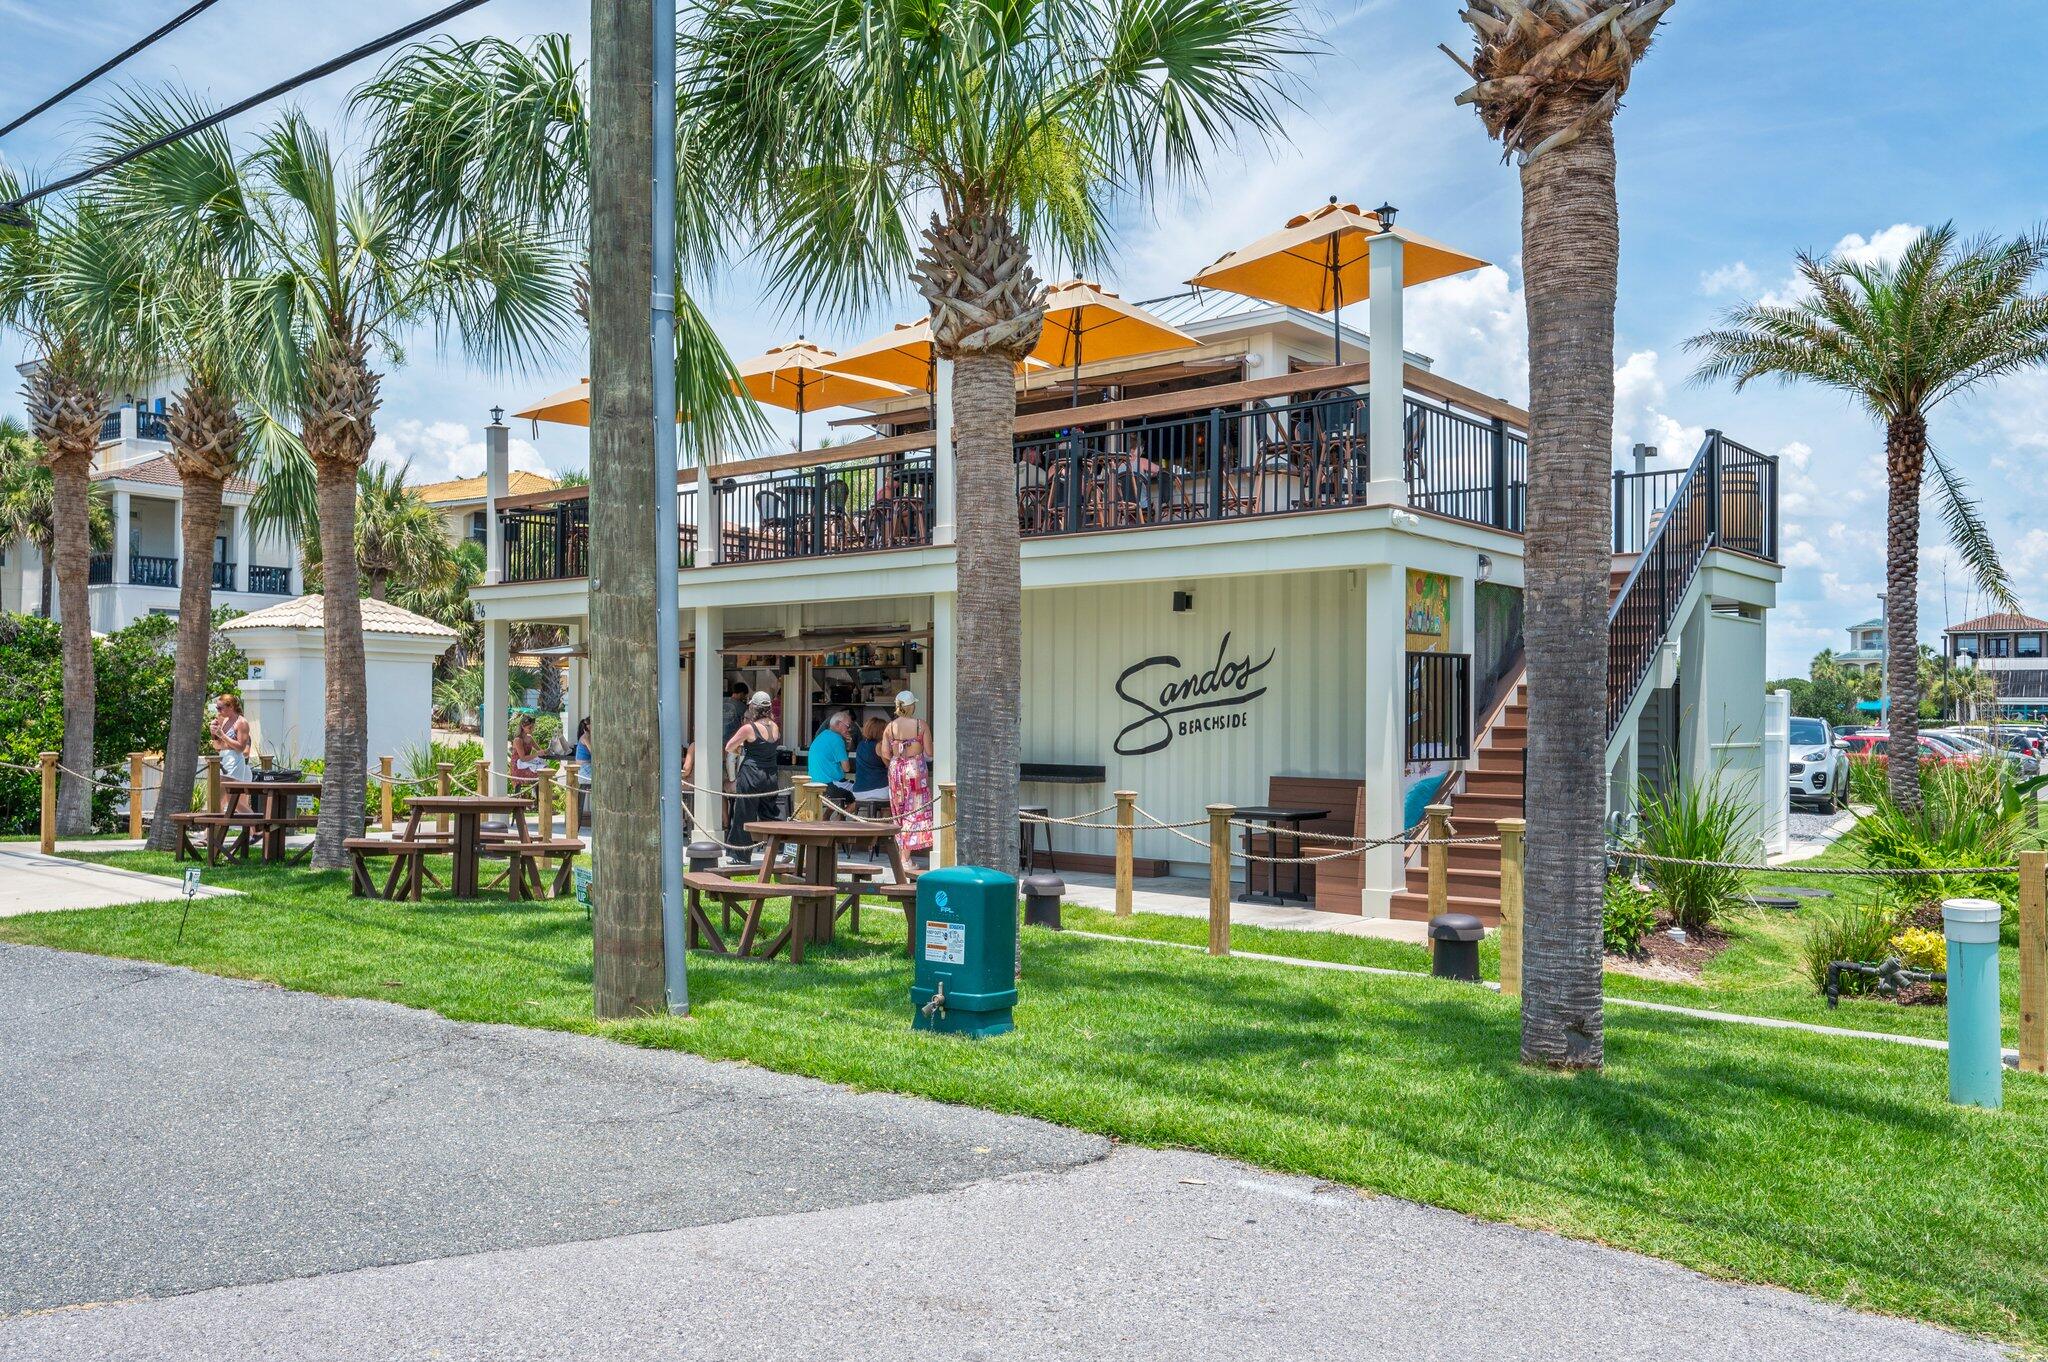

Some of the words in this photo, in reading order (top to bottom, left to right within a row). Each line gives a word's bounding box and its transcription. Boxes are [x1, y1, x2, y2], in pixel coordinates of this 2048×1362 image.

[476, 601, 486, 618] 36
[1113, 630, 1276, 756] Sandos
[1178, 711, 1248, 736] BEACHSIDE
